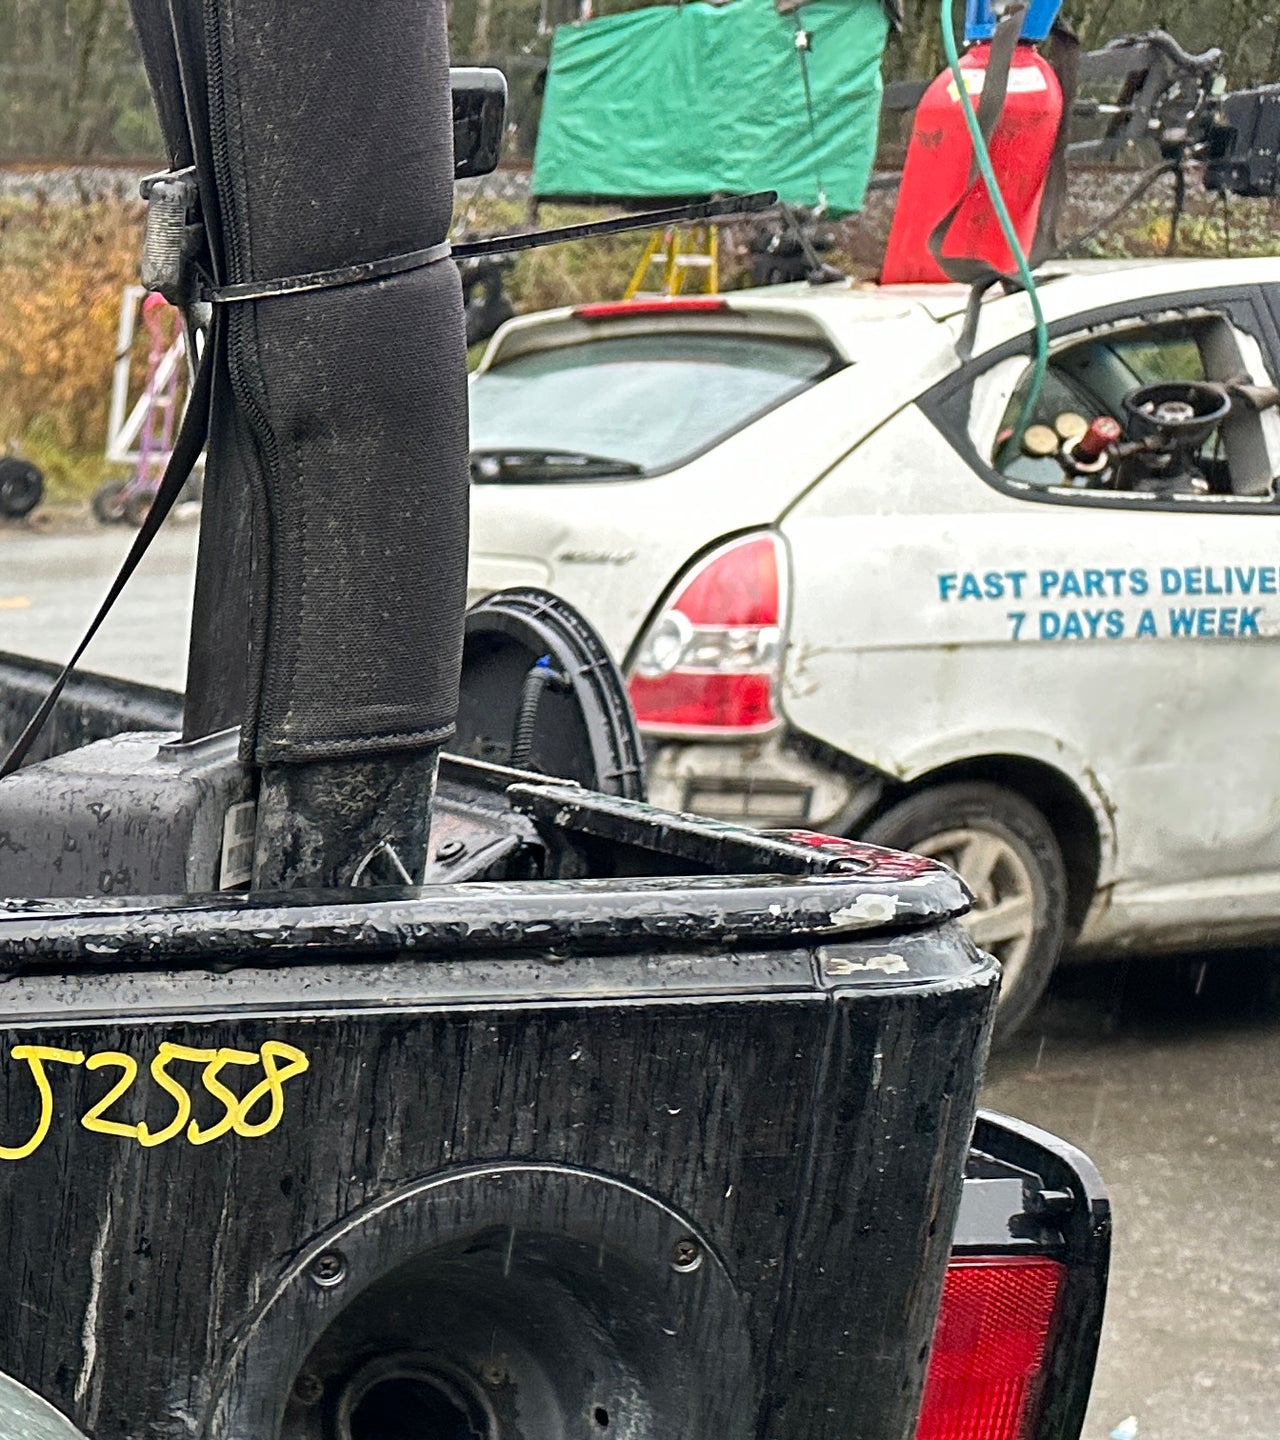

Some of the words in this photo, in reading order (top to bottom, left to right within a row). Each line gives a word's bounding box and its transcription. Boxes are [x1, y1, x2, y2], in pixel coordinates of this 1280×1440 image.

[938, 570, 1027, 600] FAST
[1039, 568, 1149, 598] PARTS
[1160, 566, 1280, 595] DELIVE
[1007, 611, 1027, 641] 7
[1039, 609, 1125, 640] DAYS
[1135, 609, 1158, 638] A
[1168, 606, 1262, 637] WEEK
